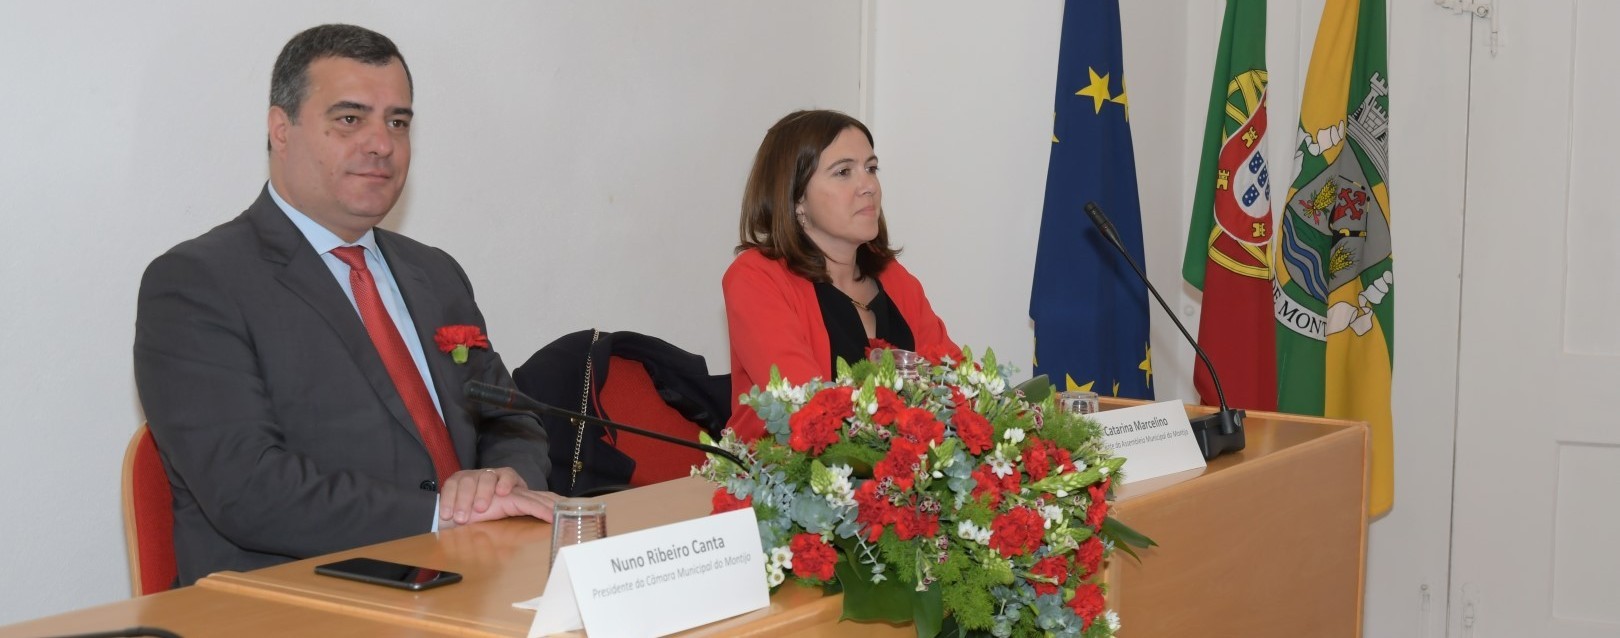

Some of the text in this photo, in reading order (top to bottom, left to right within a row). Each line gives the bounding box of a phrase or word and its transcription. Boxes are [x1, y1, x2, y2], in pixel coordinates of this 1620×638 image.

[1104, 416, 1168, 436] Catarina Marcelino
[610, 536, 725, 574] Nuno Ribeiro Canta
[592, 551, 752, 600] Presidente da Câmara Municipal do Montijo
